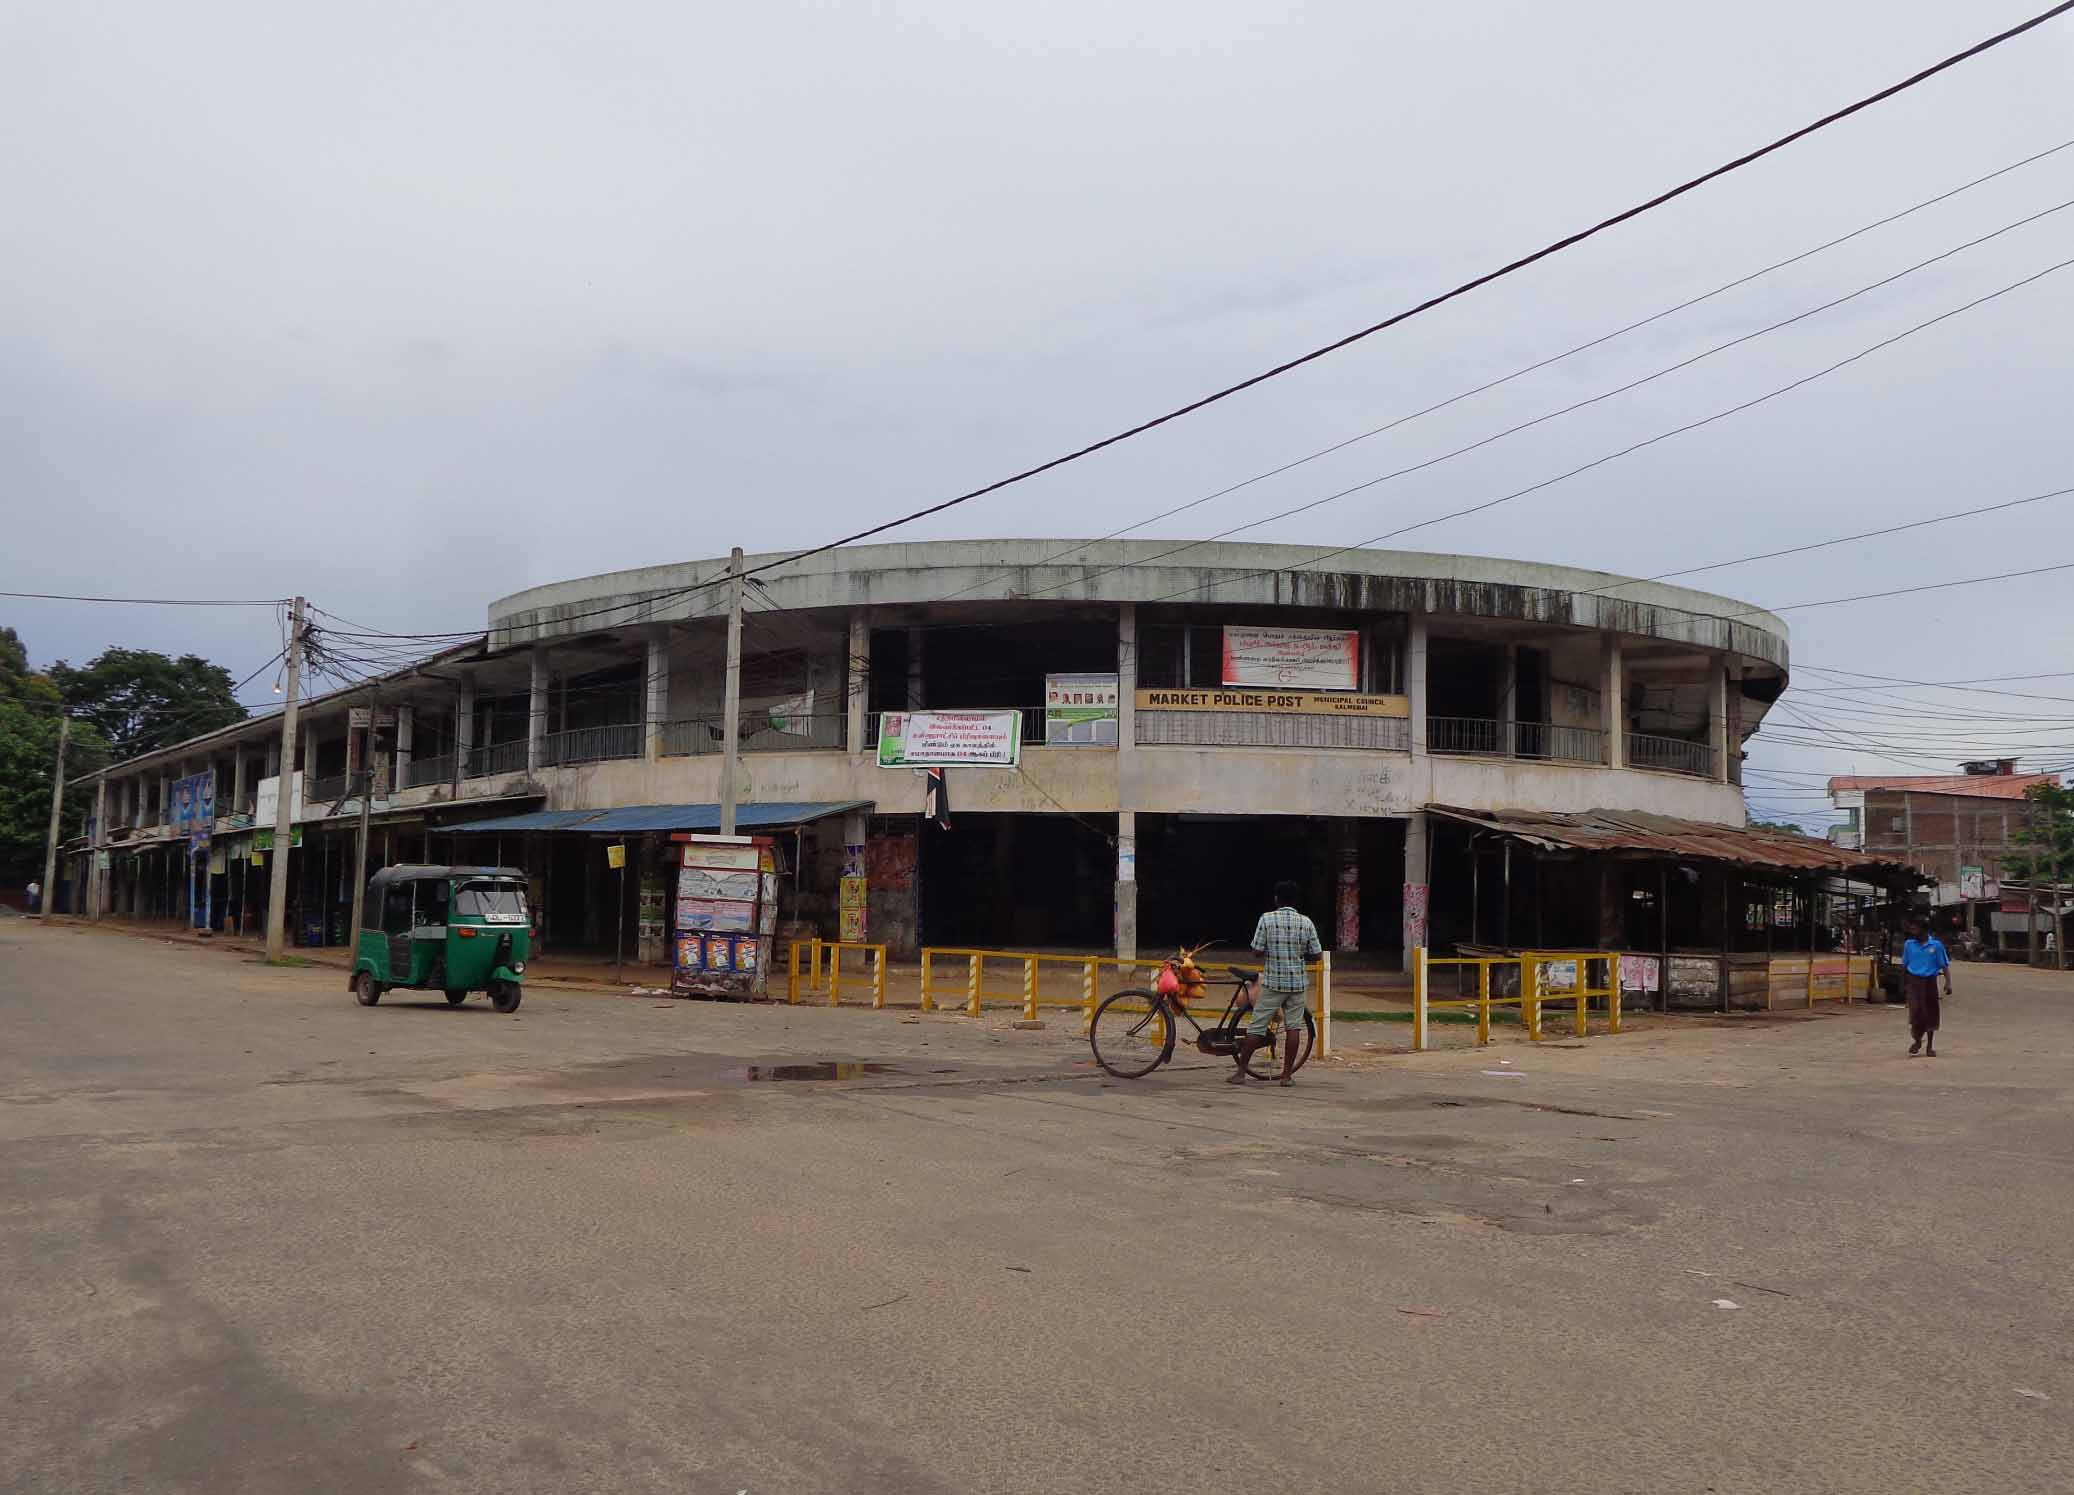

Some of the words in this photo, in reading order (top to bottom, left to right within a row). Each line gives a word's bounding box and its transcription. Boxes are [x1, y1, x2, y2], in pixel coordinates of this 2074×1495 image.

[1149, 693, 1209, 705] MARKET
[1213, 694, 1263, 706] POLICE
[1267, 695, 1303, 707] POST
[1313, 696, 1353, 704] MUNICIPAL
[1356, 698, 1385, 706] COUNCIL
